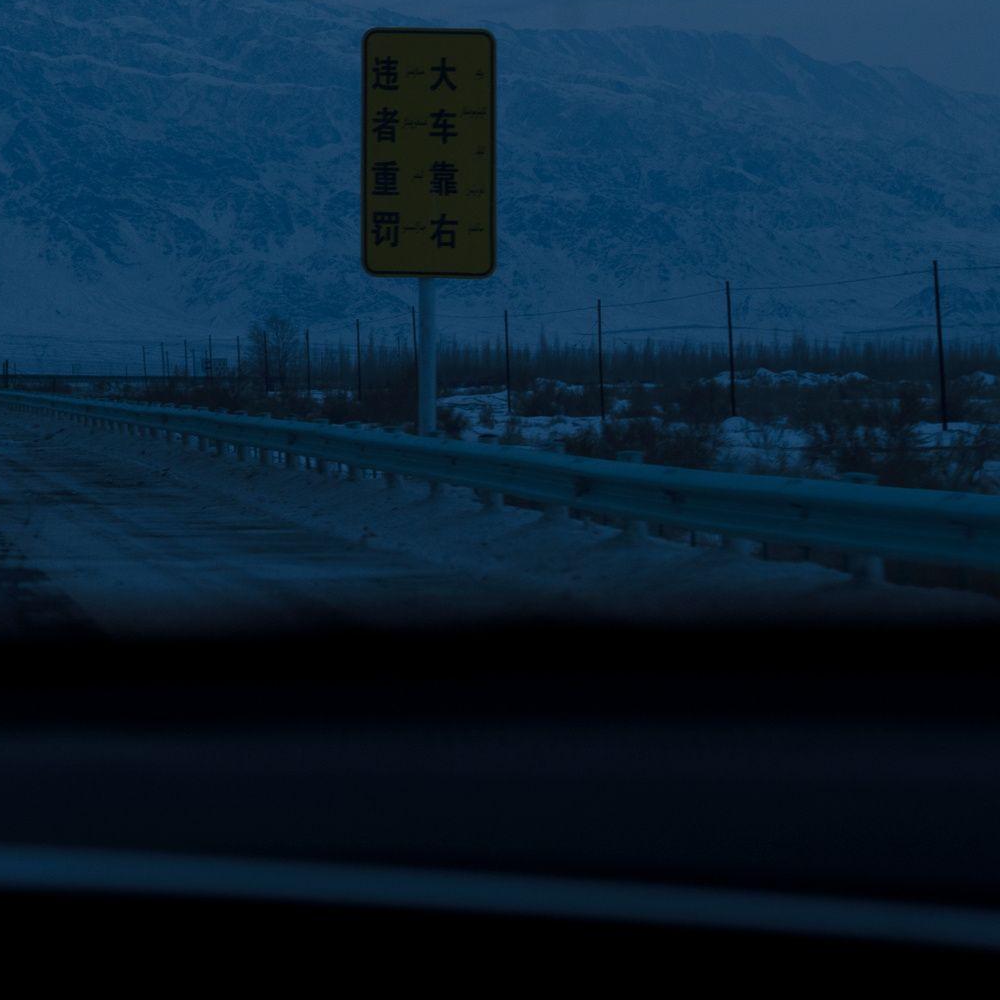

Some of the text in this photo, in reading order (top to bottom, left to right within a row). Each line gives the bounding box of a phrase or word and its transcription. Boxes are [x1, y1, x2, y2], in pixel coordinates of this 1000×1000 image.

[371, 56, 400, 248] 违者重罚
[429, 57, 459, 249] 大车靠右
